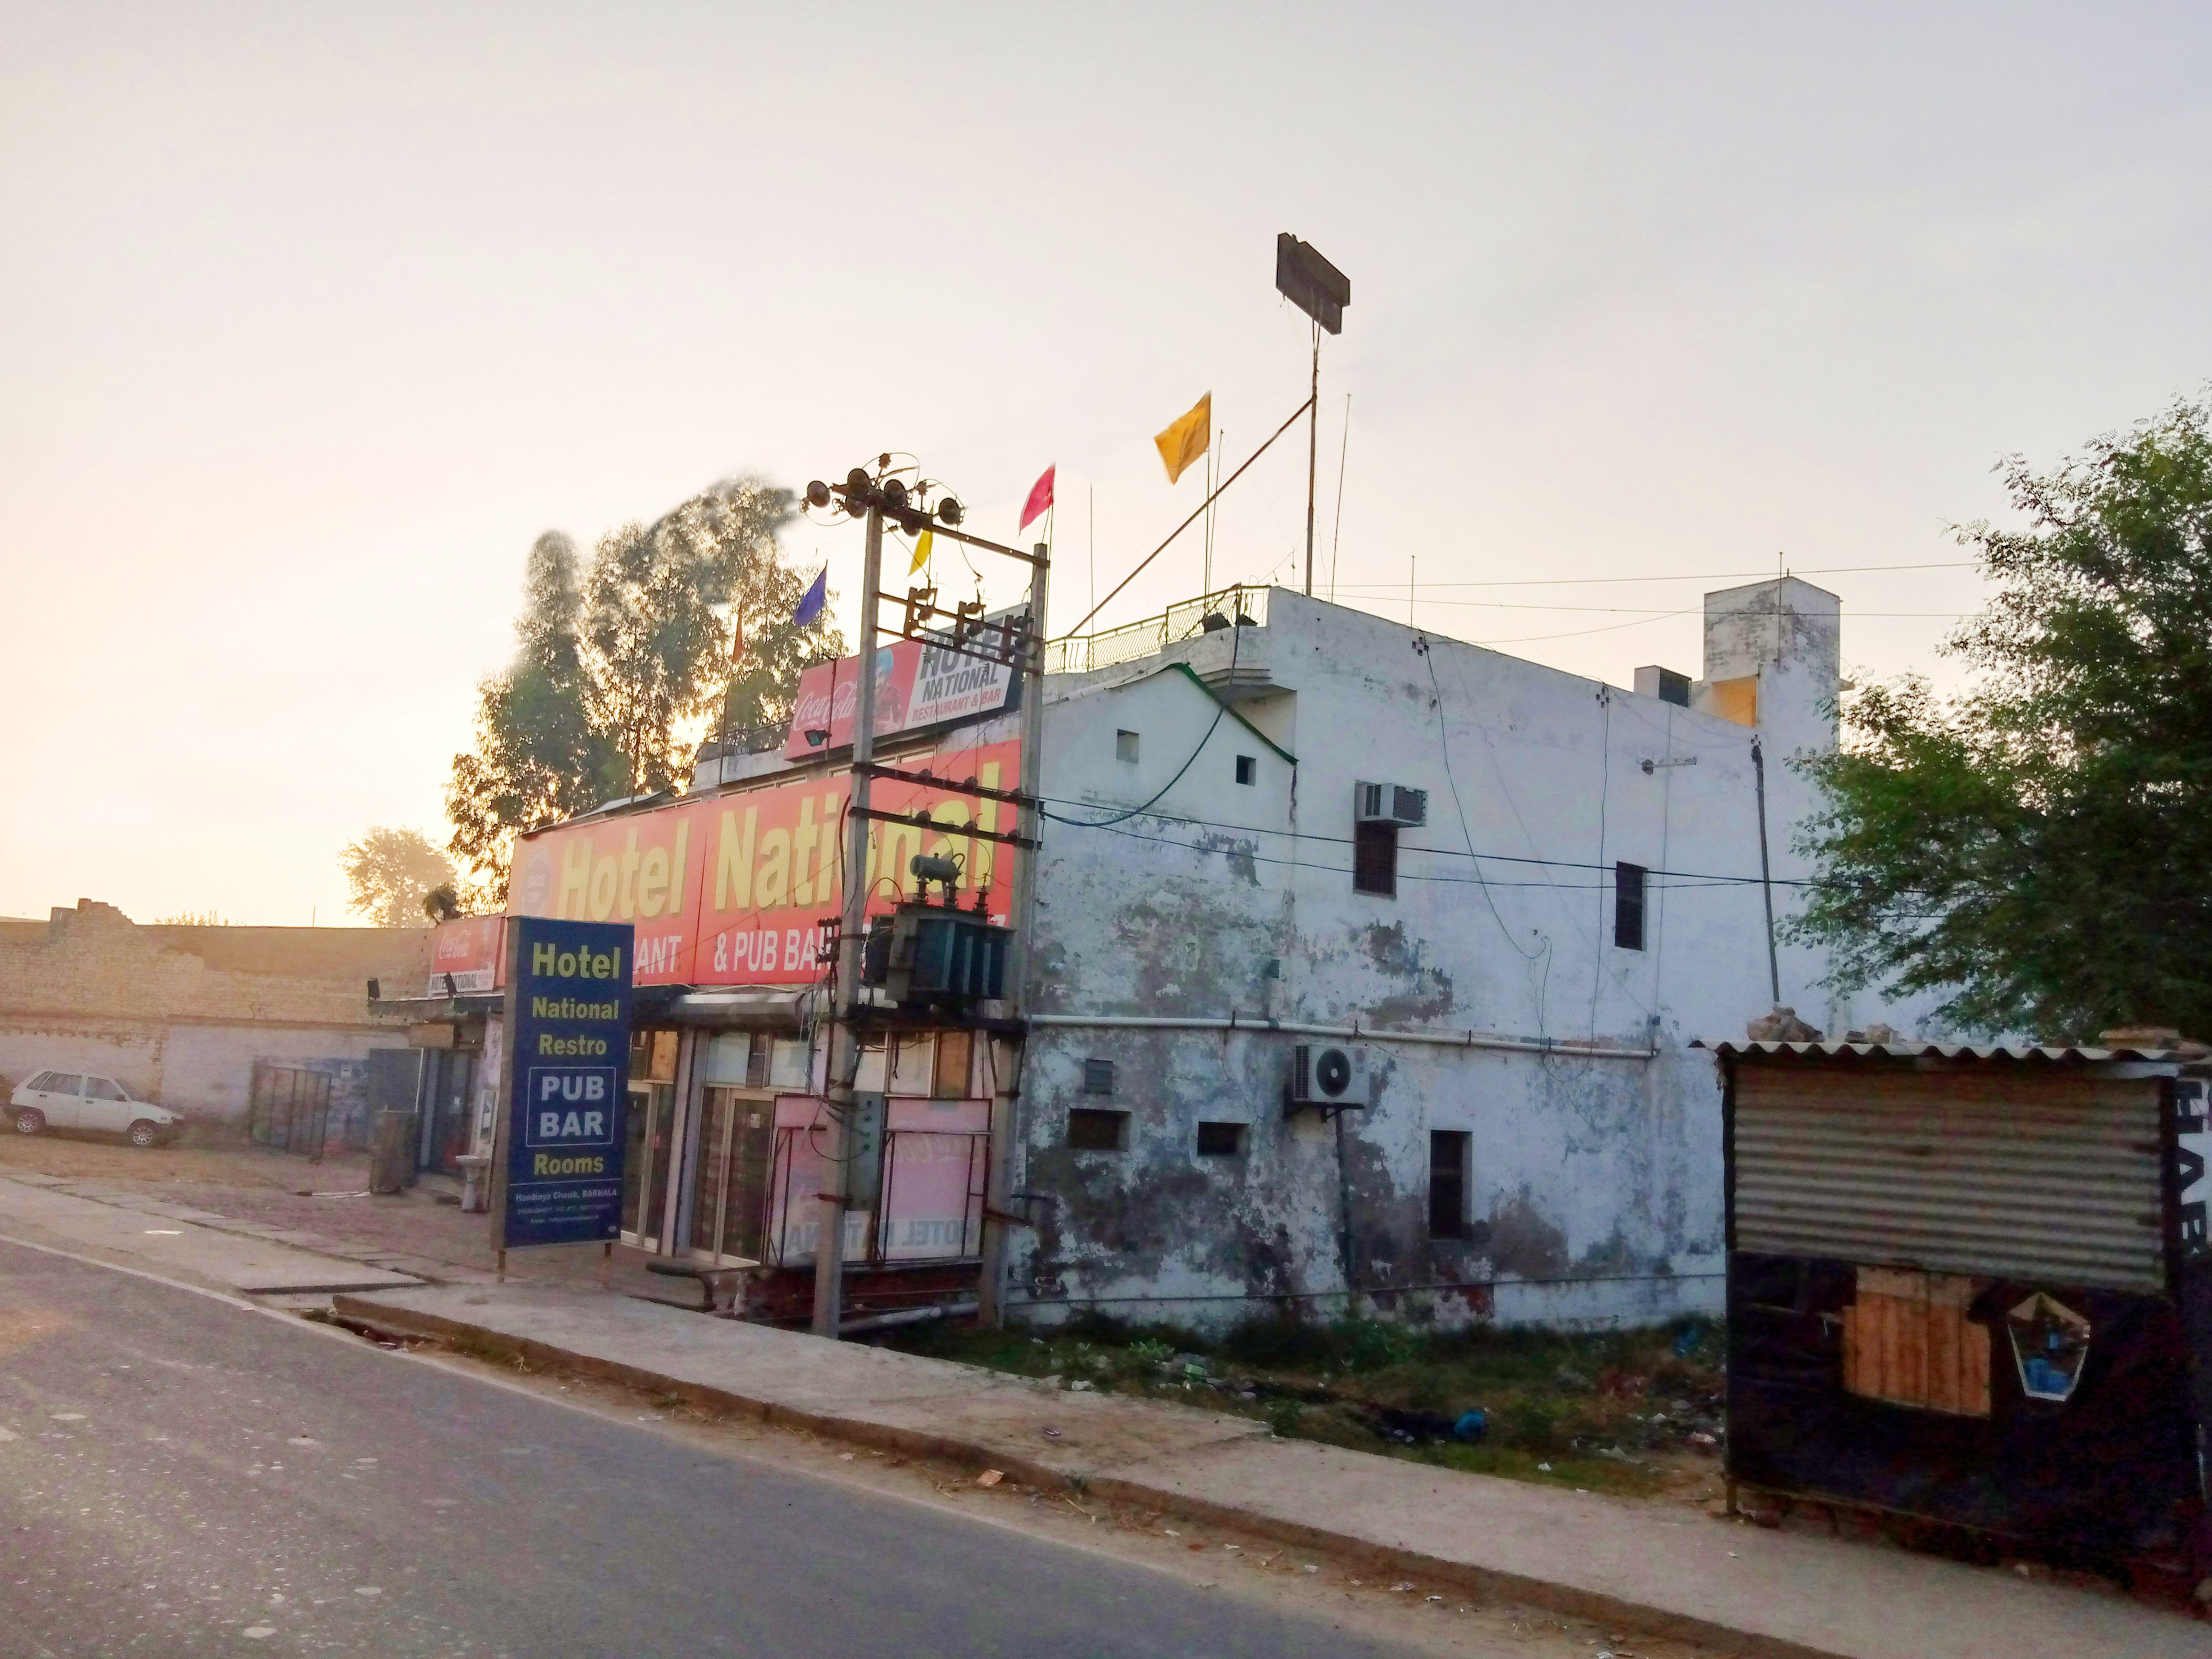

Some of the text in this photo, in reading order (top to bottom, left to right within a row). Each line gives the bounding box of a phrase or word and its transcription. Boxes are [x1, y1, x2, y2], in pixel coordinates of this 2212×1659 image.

[920, 616, 1012, 680] HOE
[922, 664, 998, 703] NATIONAL
[912, 688, 1001, 722] RESTAURANT & BAR
[556, 819, 690, 922] Hotel
[532, 942, 621, 979] Hotel
[714, 932, 727, 972] &
[733, 930, 778, 972] PUB
[532, 996, 619, 1020] National
[539, 1034, 607, 1055] Restro
[541, 1076, 605, 1101] PUB
[540, 1111, 604, 1137] BAR
[534, 1153, 604, 1176] Rooms
[582, 1188, 617, 1198] BARNALA
